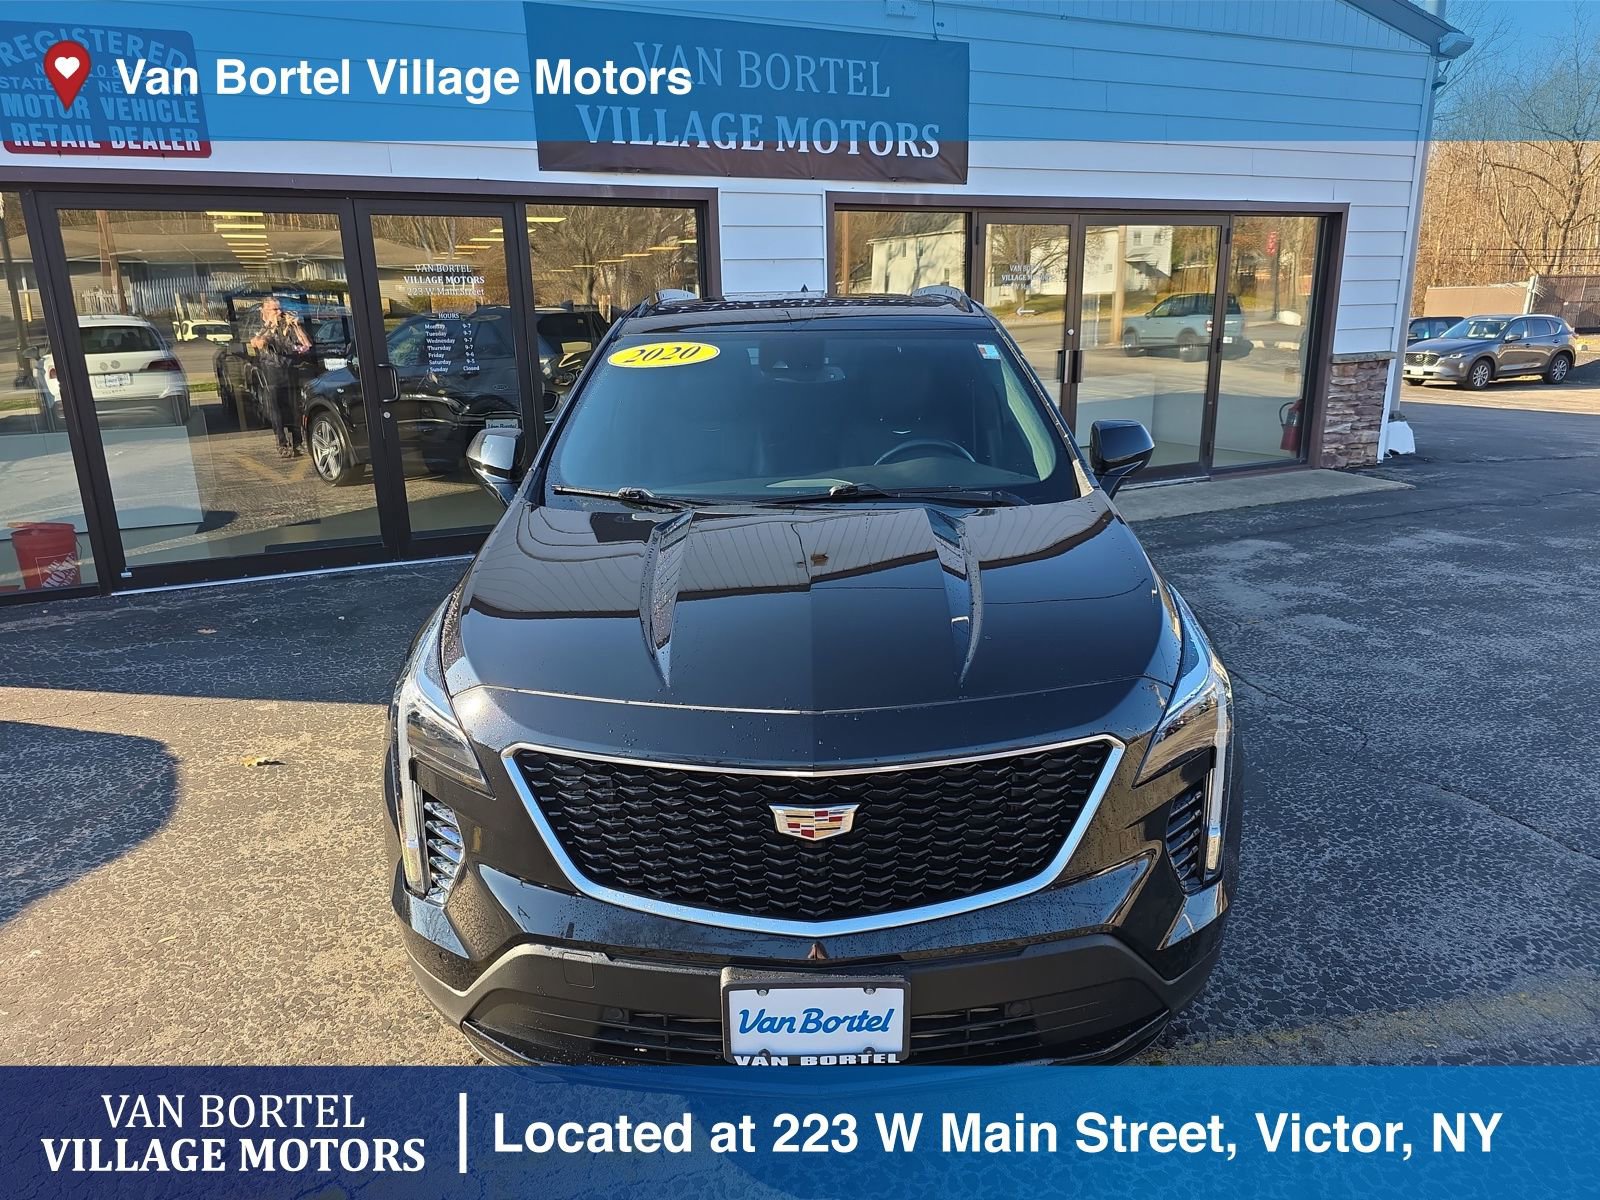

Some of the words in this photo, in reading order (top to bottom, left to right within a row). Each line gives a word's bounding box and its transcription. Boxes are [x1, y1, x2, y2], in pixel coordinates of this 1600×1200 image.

[0, 28, 188, 70] REGISTERED
[633, 41, 723, 86] VAN
[737, 49, 890, 98] BORTEL
[1, 93, 91, 120] MOTOR
[100, 96, 200, 124] VEHICLE
[11, 122, 101, 149] RETAIL
[108, 126, 201, 151] DEALER
[575, 104, 763, 152] VILLAGE
[775, 115, 940, 159] MOTORS
[404, 276, 443, 284] VILLAGE
[446, 276, 485, 284] MOTORS
[415, 264, 434, 272] VAN
[437, 264, 471, 272] BORTEL
[622, 345, 701, 363] 2020
[738, 1008, 797, 1034] Van
[798, 1007, 896, 1034] Bortel
[734, 1055, 789, 1067] VAN
[800, 1053, 900, 1067] BORTEL
